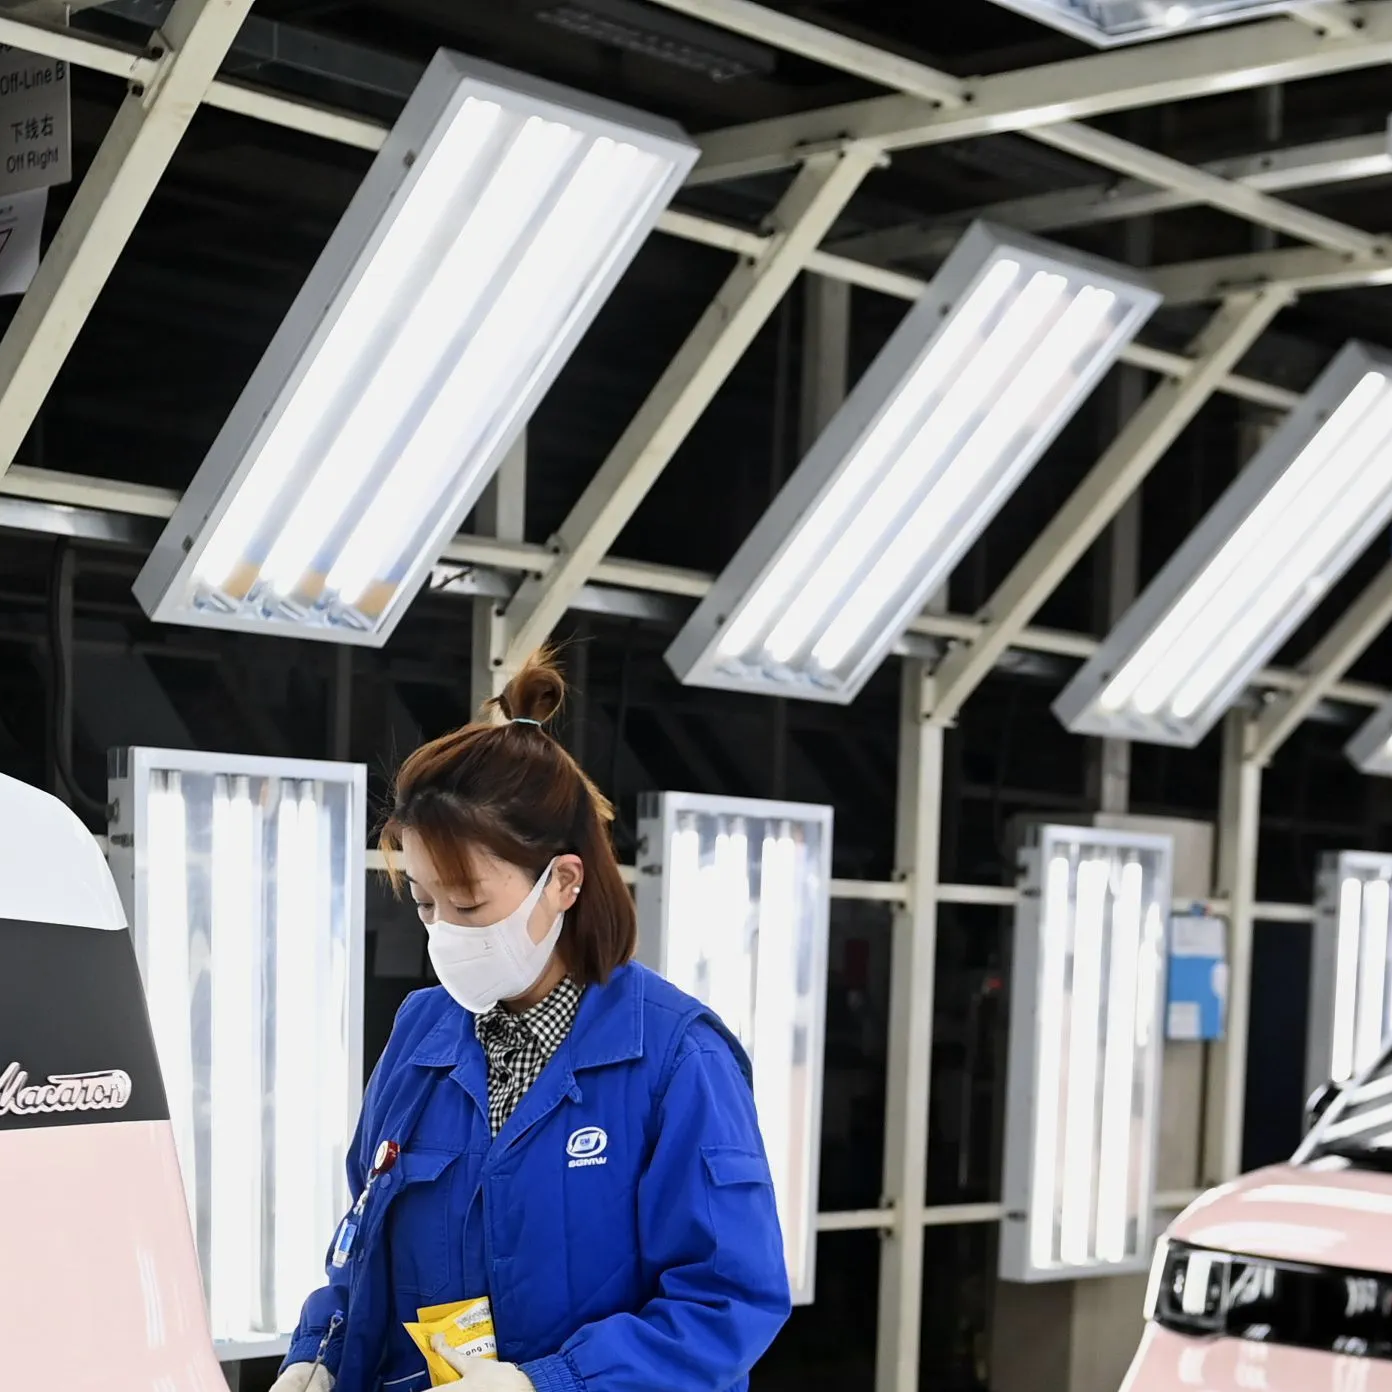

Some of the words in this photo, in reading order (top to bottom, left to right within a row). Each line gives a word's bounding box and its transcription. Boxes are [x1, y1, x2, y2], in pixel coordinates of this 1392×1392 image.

[0, 67, 52, 96] Off-Line
[10, 113, 54, 143] 下线右
[7, 153, 26, 174] Off
[28, 147, 59, 170] Right
